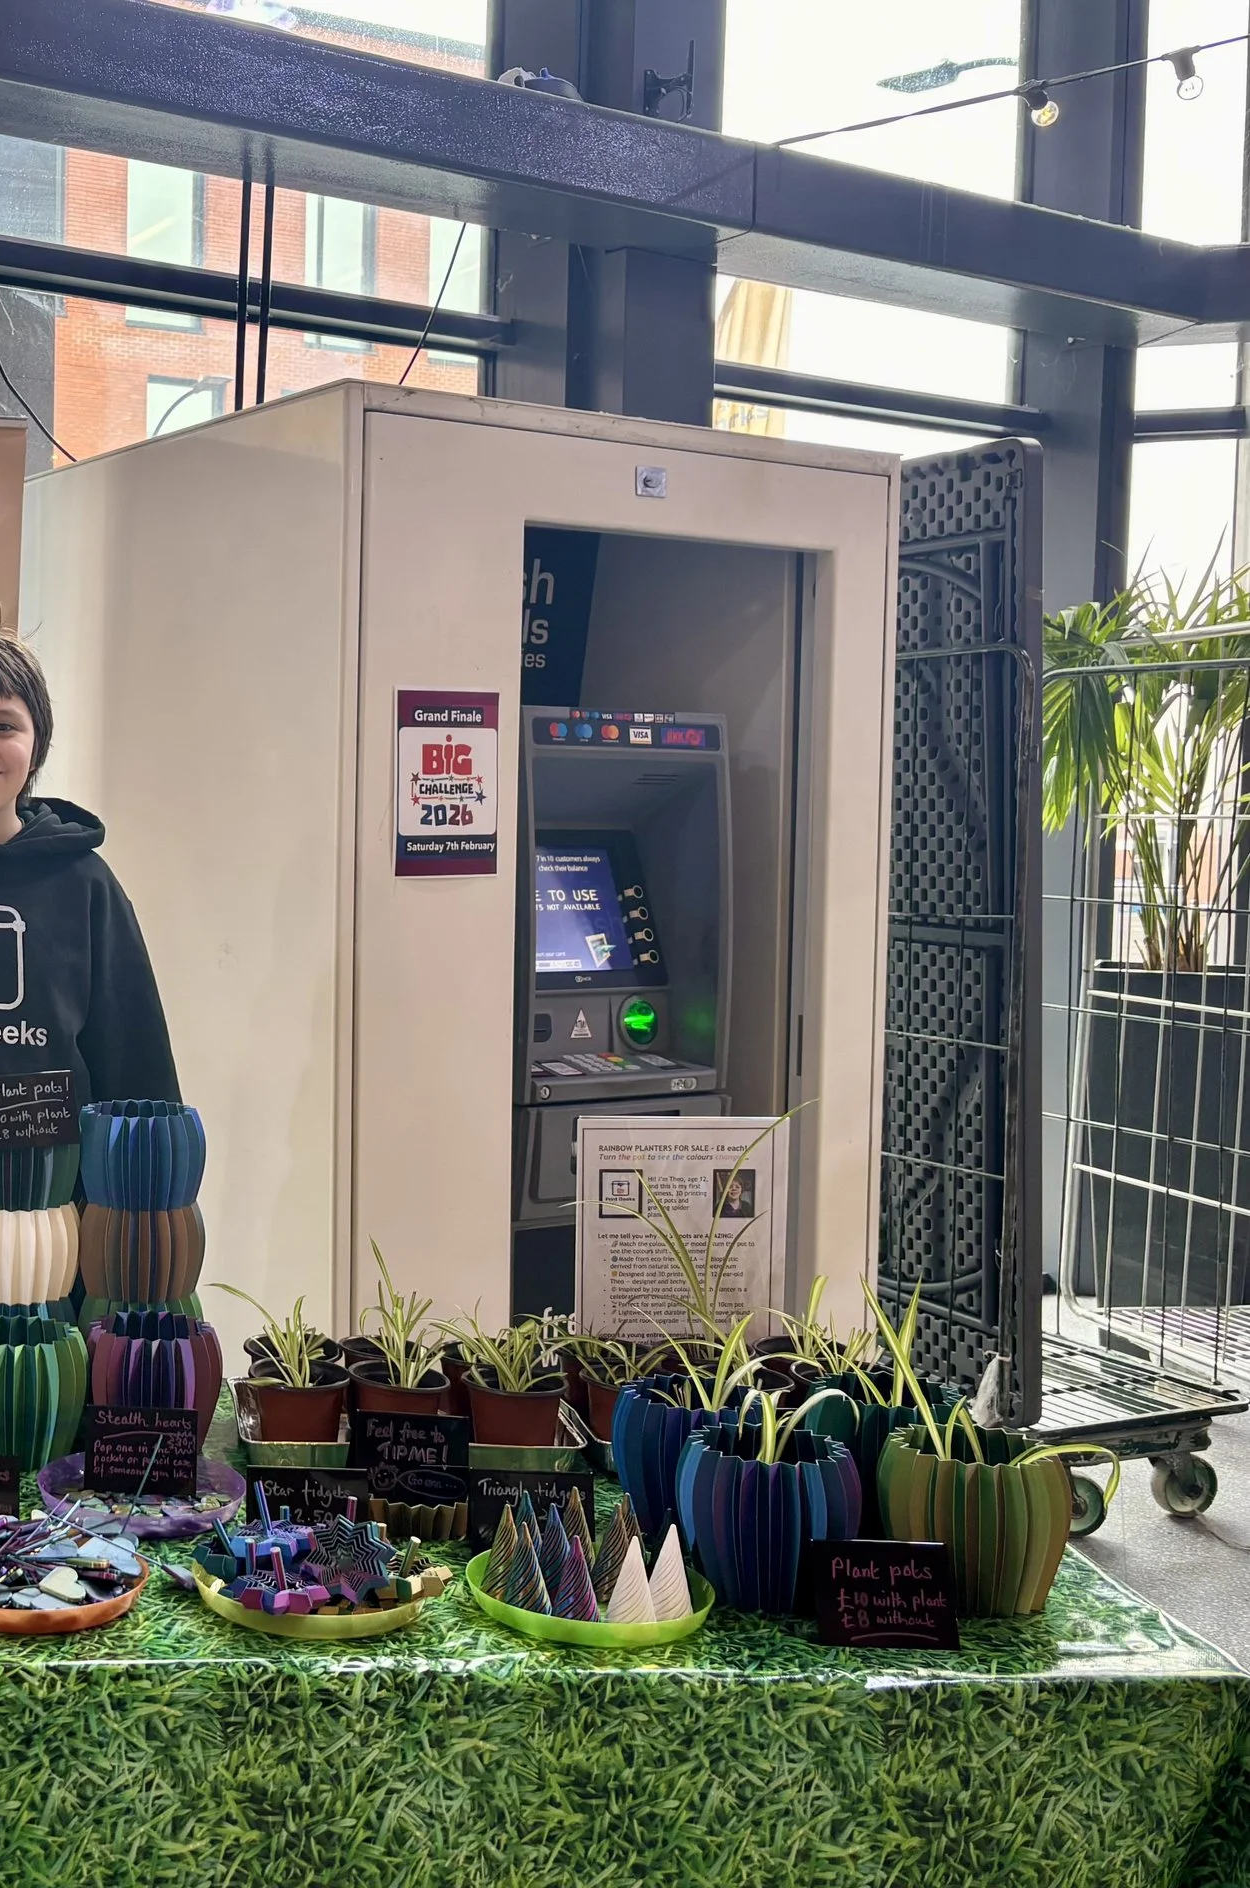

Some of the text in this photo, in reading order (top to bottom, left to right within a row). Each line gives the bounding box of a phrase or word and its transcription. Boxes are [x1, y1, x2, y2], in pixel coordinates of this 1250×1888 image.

[414, 710, 482, 723] Grand Finale
[633, 731, 649, 740] VISA
[419, 783, 474, 795] CHALLENGE
[420, 804, 473, 826] 2026
[406, 841, 495, 853] Saturday 7th February
[538, 865, 554, 873] check
[567, 865, 588, 873] balance
[547, 889, 566, 901] TO
[573, 889, 599, 901] USE
[563, 903, 601, 911] AVAILABLE
[10, 1110, 32, 1122] with
[37, 1107, 70, 1123] plant
[15, 1122, 59, 1138] without
[619, 1271, 644, 1279] Designed
[95, 1409, 192, 1429] Stealth hearts
[367, 1418, 446, 1443] Feel free to
[94, 1440, 112, 1453] Pop
[116, 1444, 133, 1453] one
[264, 1480, 295, 1496] Star
[478, 1477, 523, 1508] Triangl
[831, 1557, 933, 1585] Plant pots
[837, 1588, 947, 1612] £10 with plant
[841, 1609, 936, 1628] £8 without
